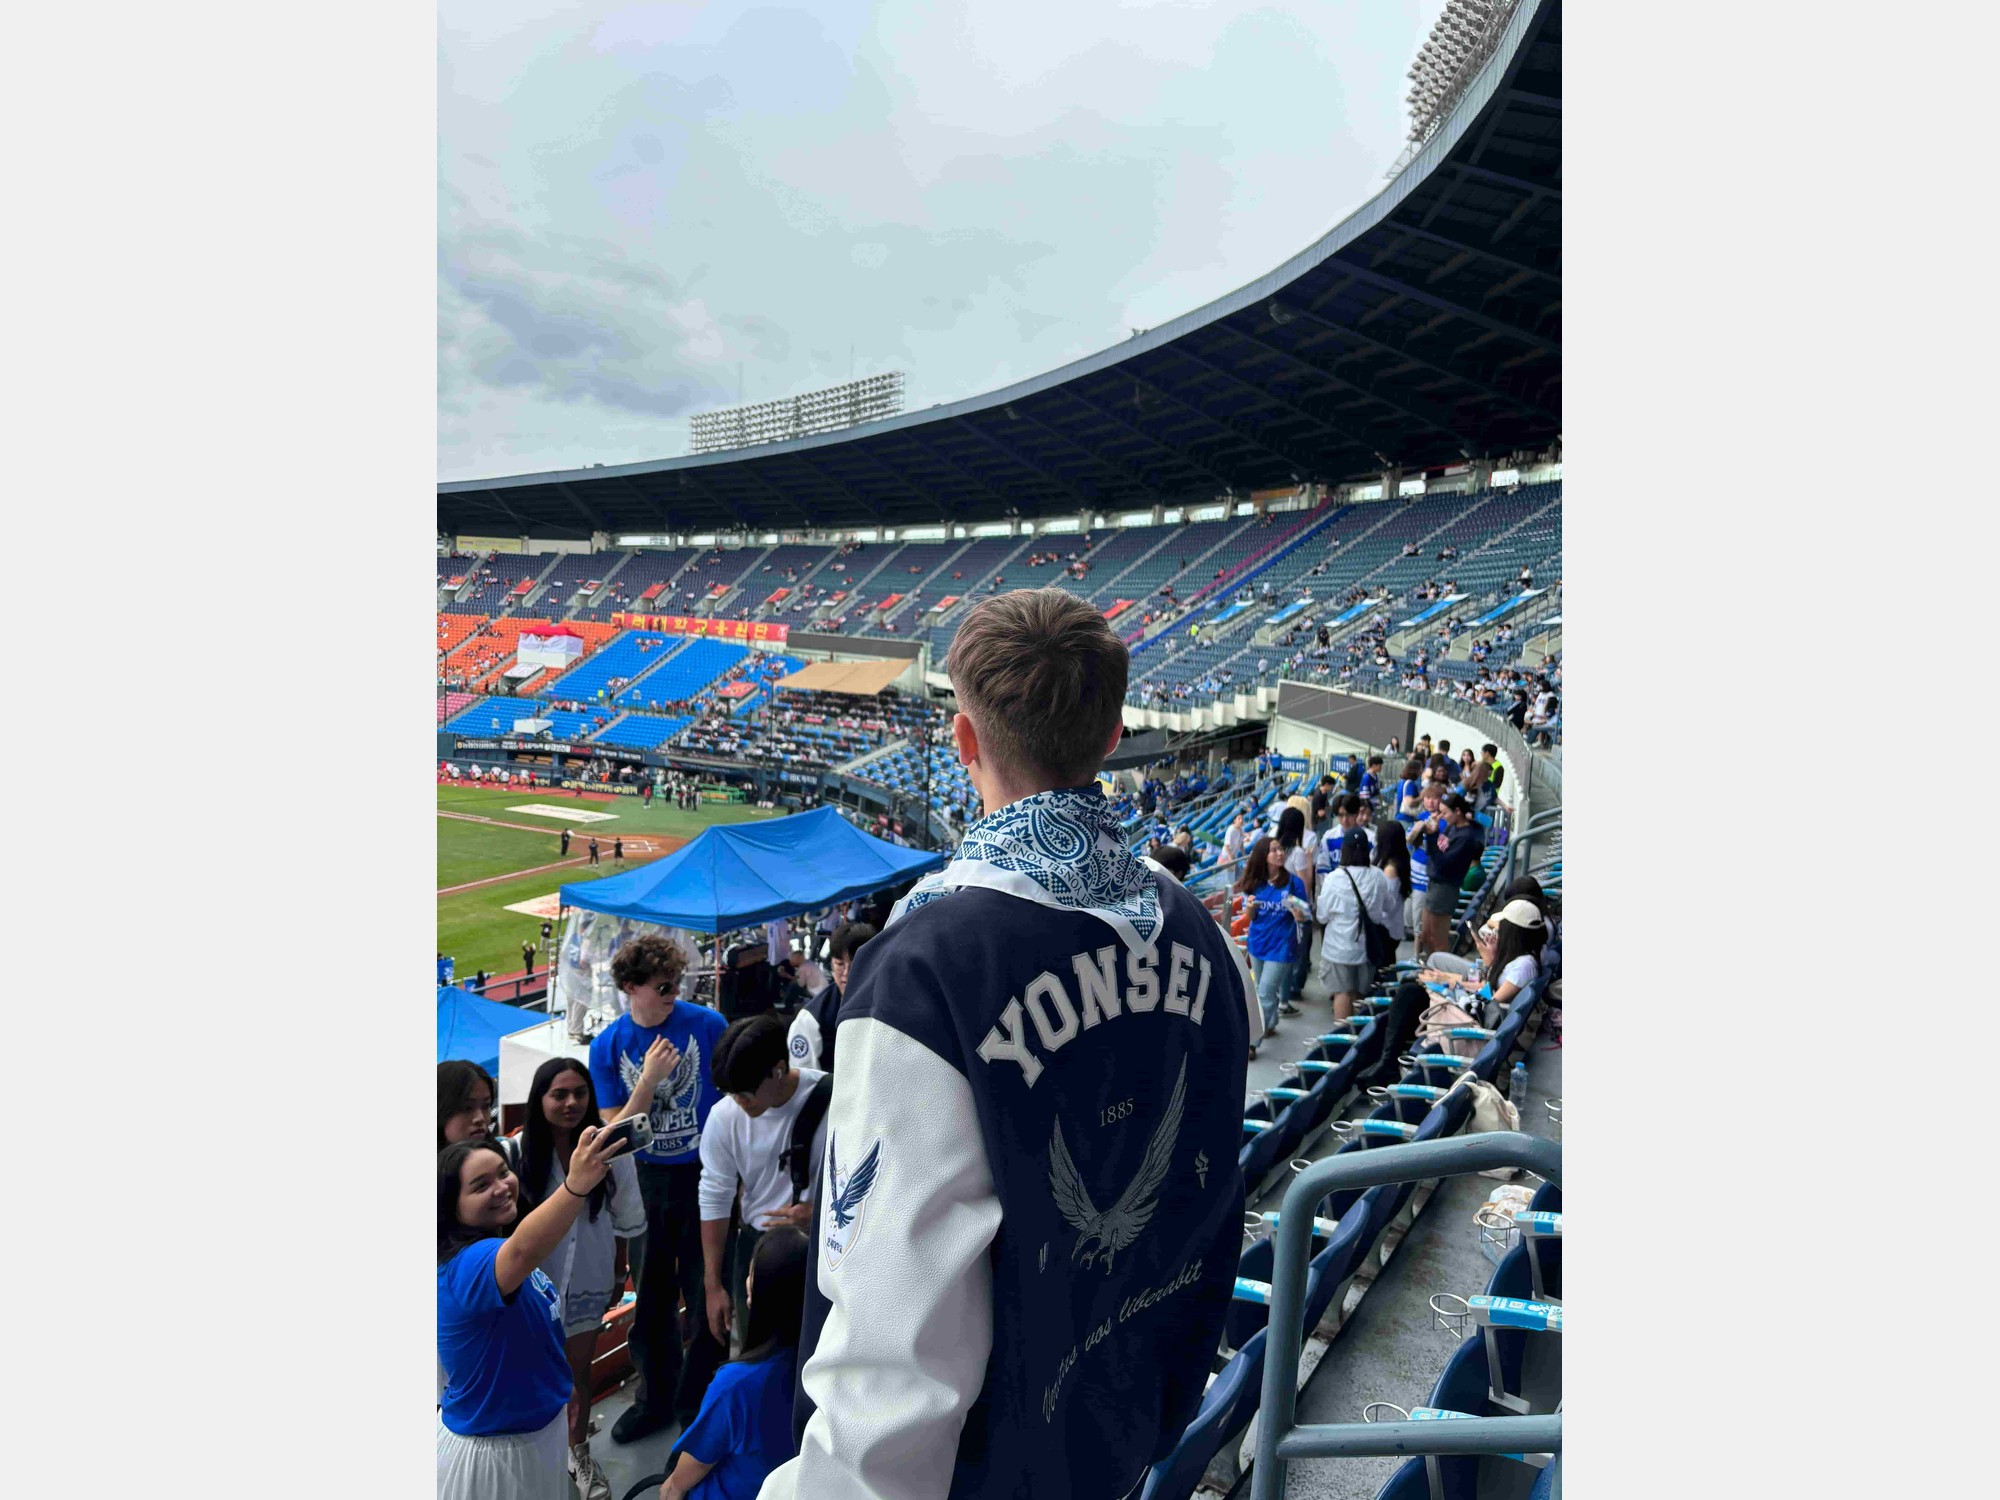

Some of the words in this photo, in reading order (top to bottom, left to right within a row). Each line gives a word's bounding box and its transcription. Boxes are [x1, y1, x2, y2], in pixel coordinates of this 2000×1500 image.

[967, 828, 999, 844] YONS
[1000, 838, 1044, 867] YONSEI
[1048, 862, 1083, 895] YONSEI
[976, 940, 1212, 1089] YONSEI
[657, 1137, 683, 1150] 1885
[1099, 1098, 1134, 1127] 1885
[1085, 1315, 1113, 1352] vos
[1119, 1258, 1203, 1323] liberabit
